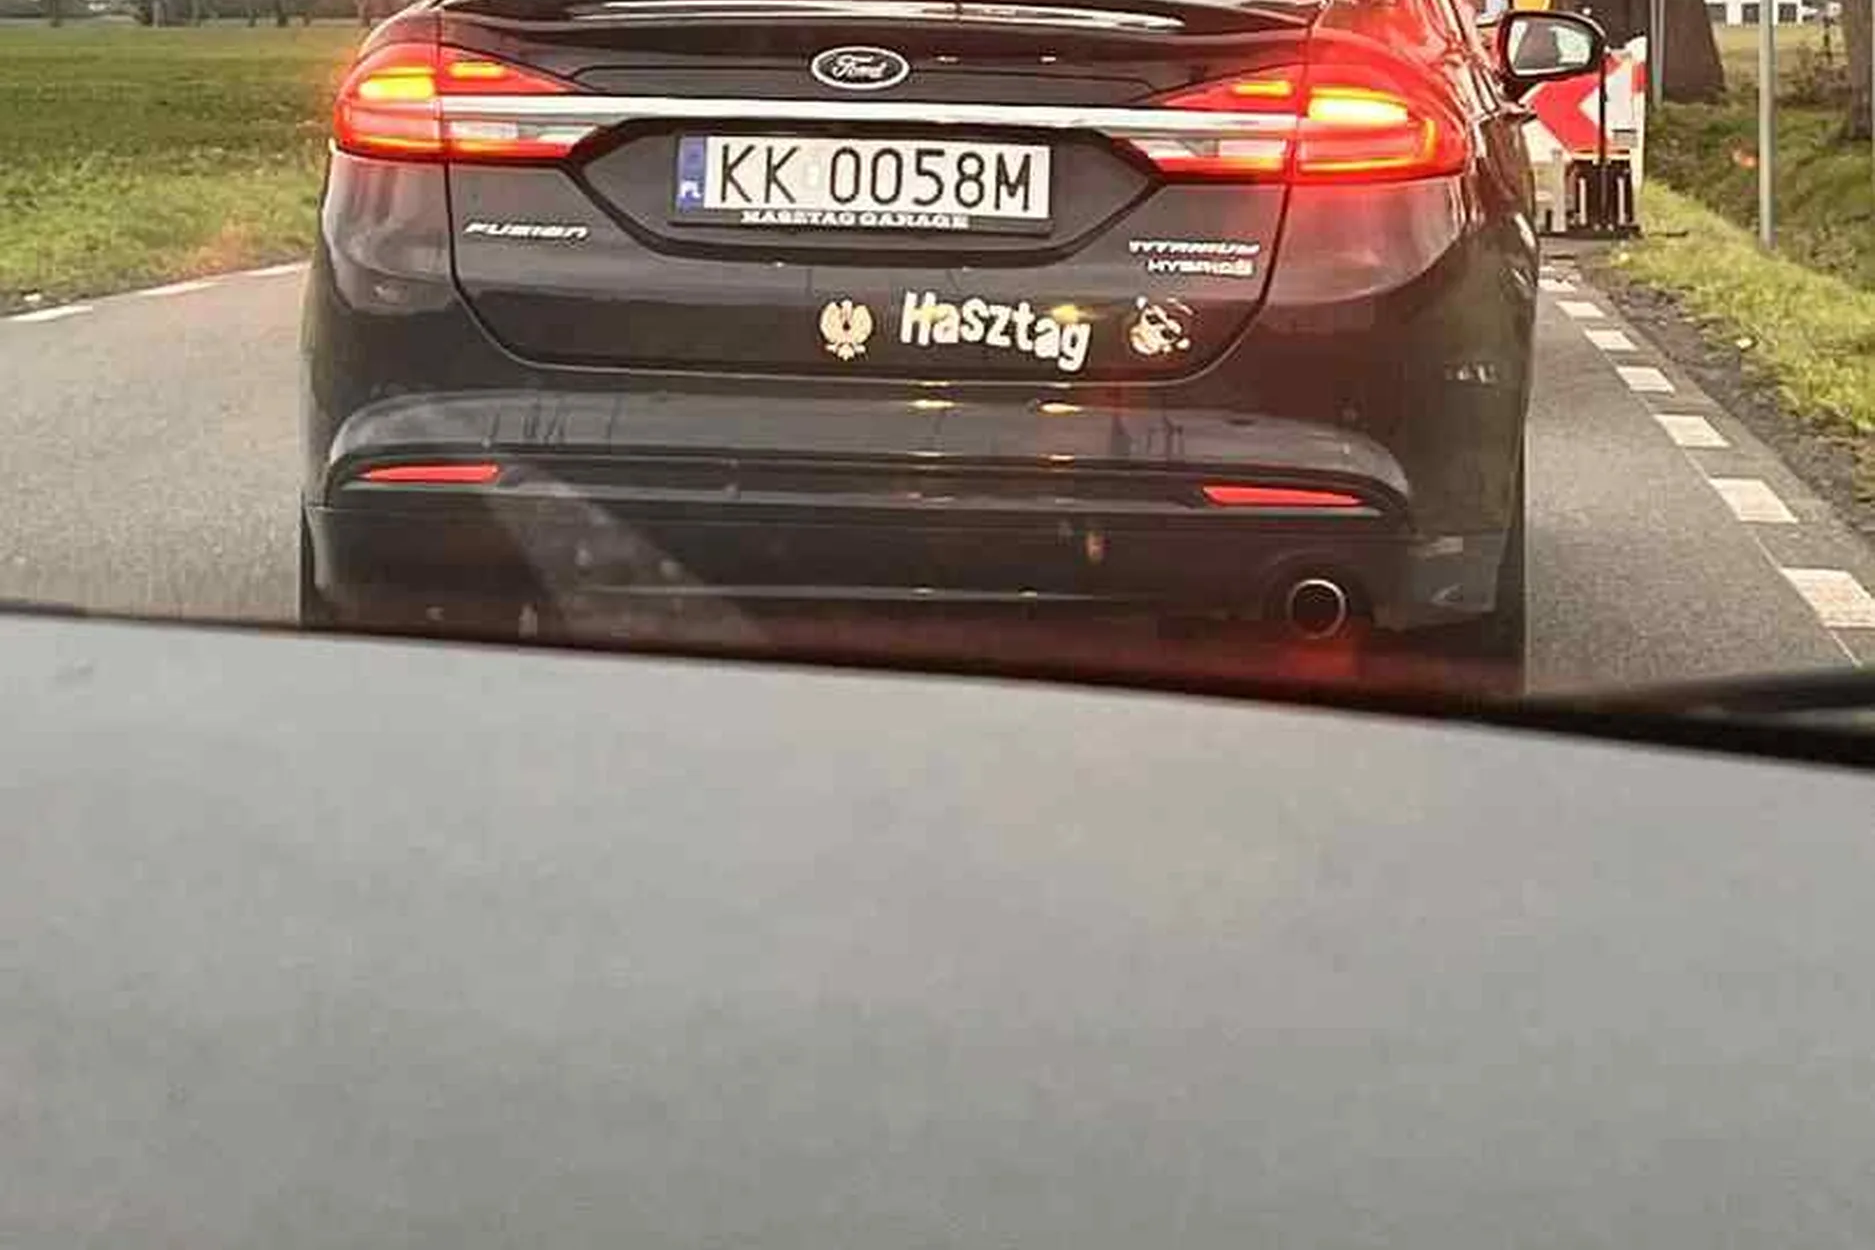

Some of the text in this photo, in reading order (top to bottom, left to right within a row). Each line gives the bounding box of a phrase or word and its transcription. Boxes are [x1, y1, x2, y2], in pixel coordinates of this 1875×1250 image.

[833, 54, 887, 79] Ford
[720, 144, 1032, 211] KK 0058M
[900, 291, 1092, 372] Hasztag
